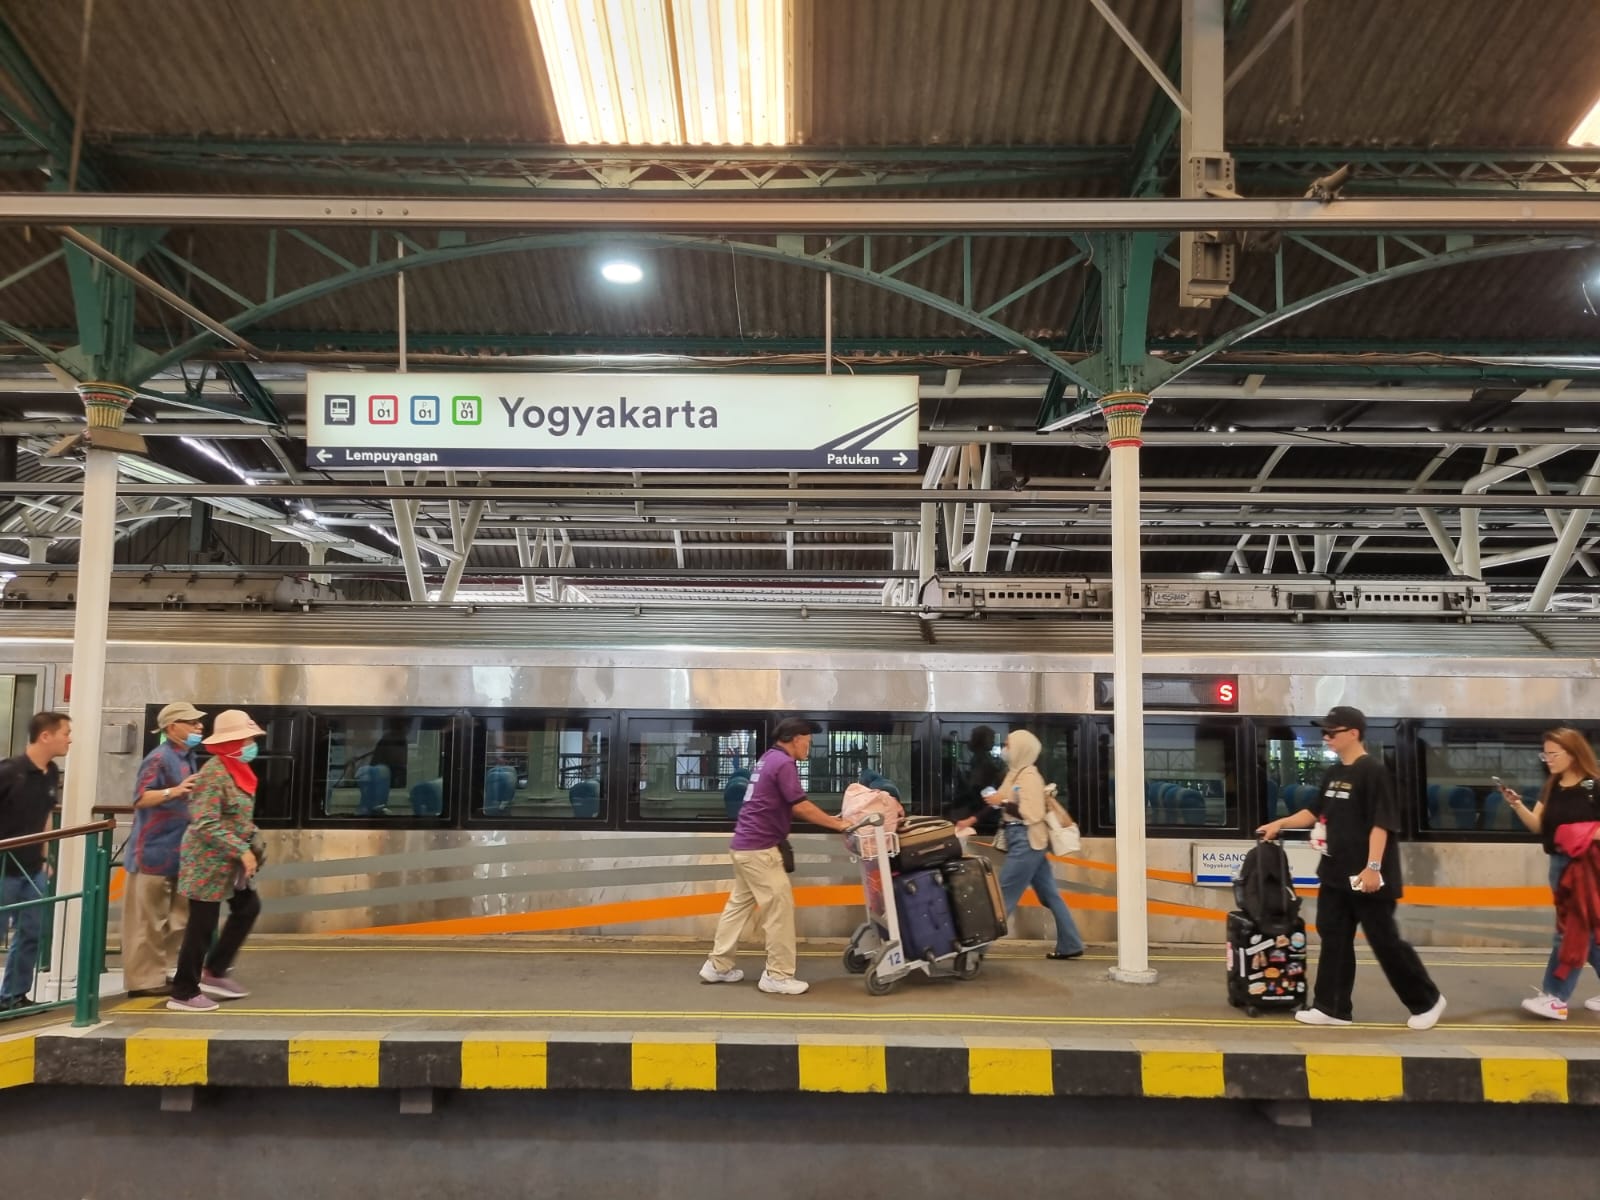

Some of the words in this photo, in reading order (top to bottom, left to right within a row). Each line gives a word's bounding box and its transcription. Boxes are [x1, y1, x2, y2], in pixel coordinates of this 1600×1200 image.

[461, 401, 473, 409] YA
[378, 408, 391, 418] 01
[419, 409, 432, 419] 01
[461, 410, 474, 419] 01
[498, 397, 718, 436] Yogyakarta
[345, 449, 438, 464] Lempuyangan
[827, 453, 880, 465] Patukan
[1220, 684, 1233, 701] S
[1202, 853, 1216, 861] KA
[888, 952, 901, 966] 12
